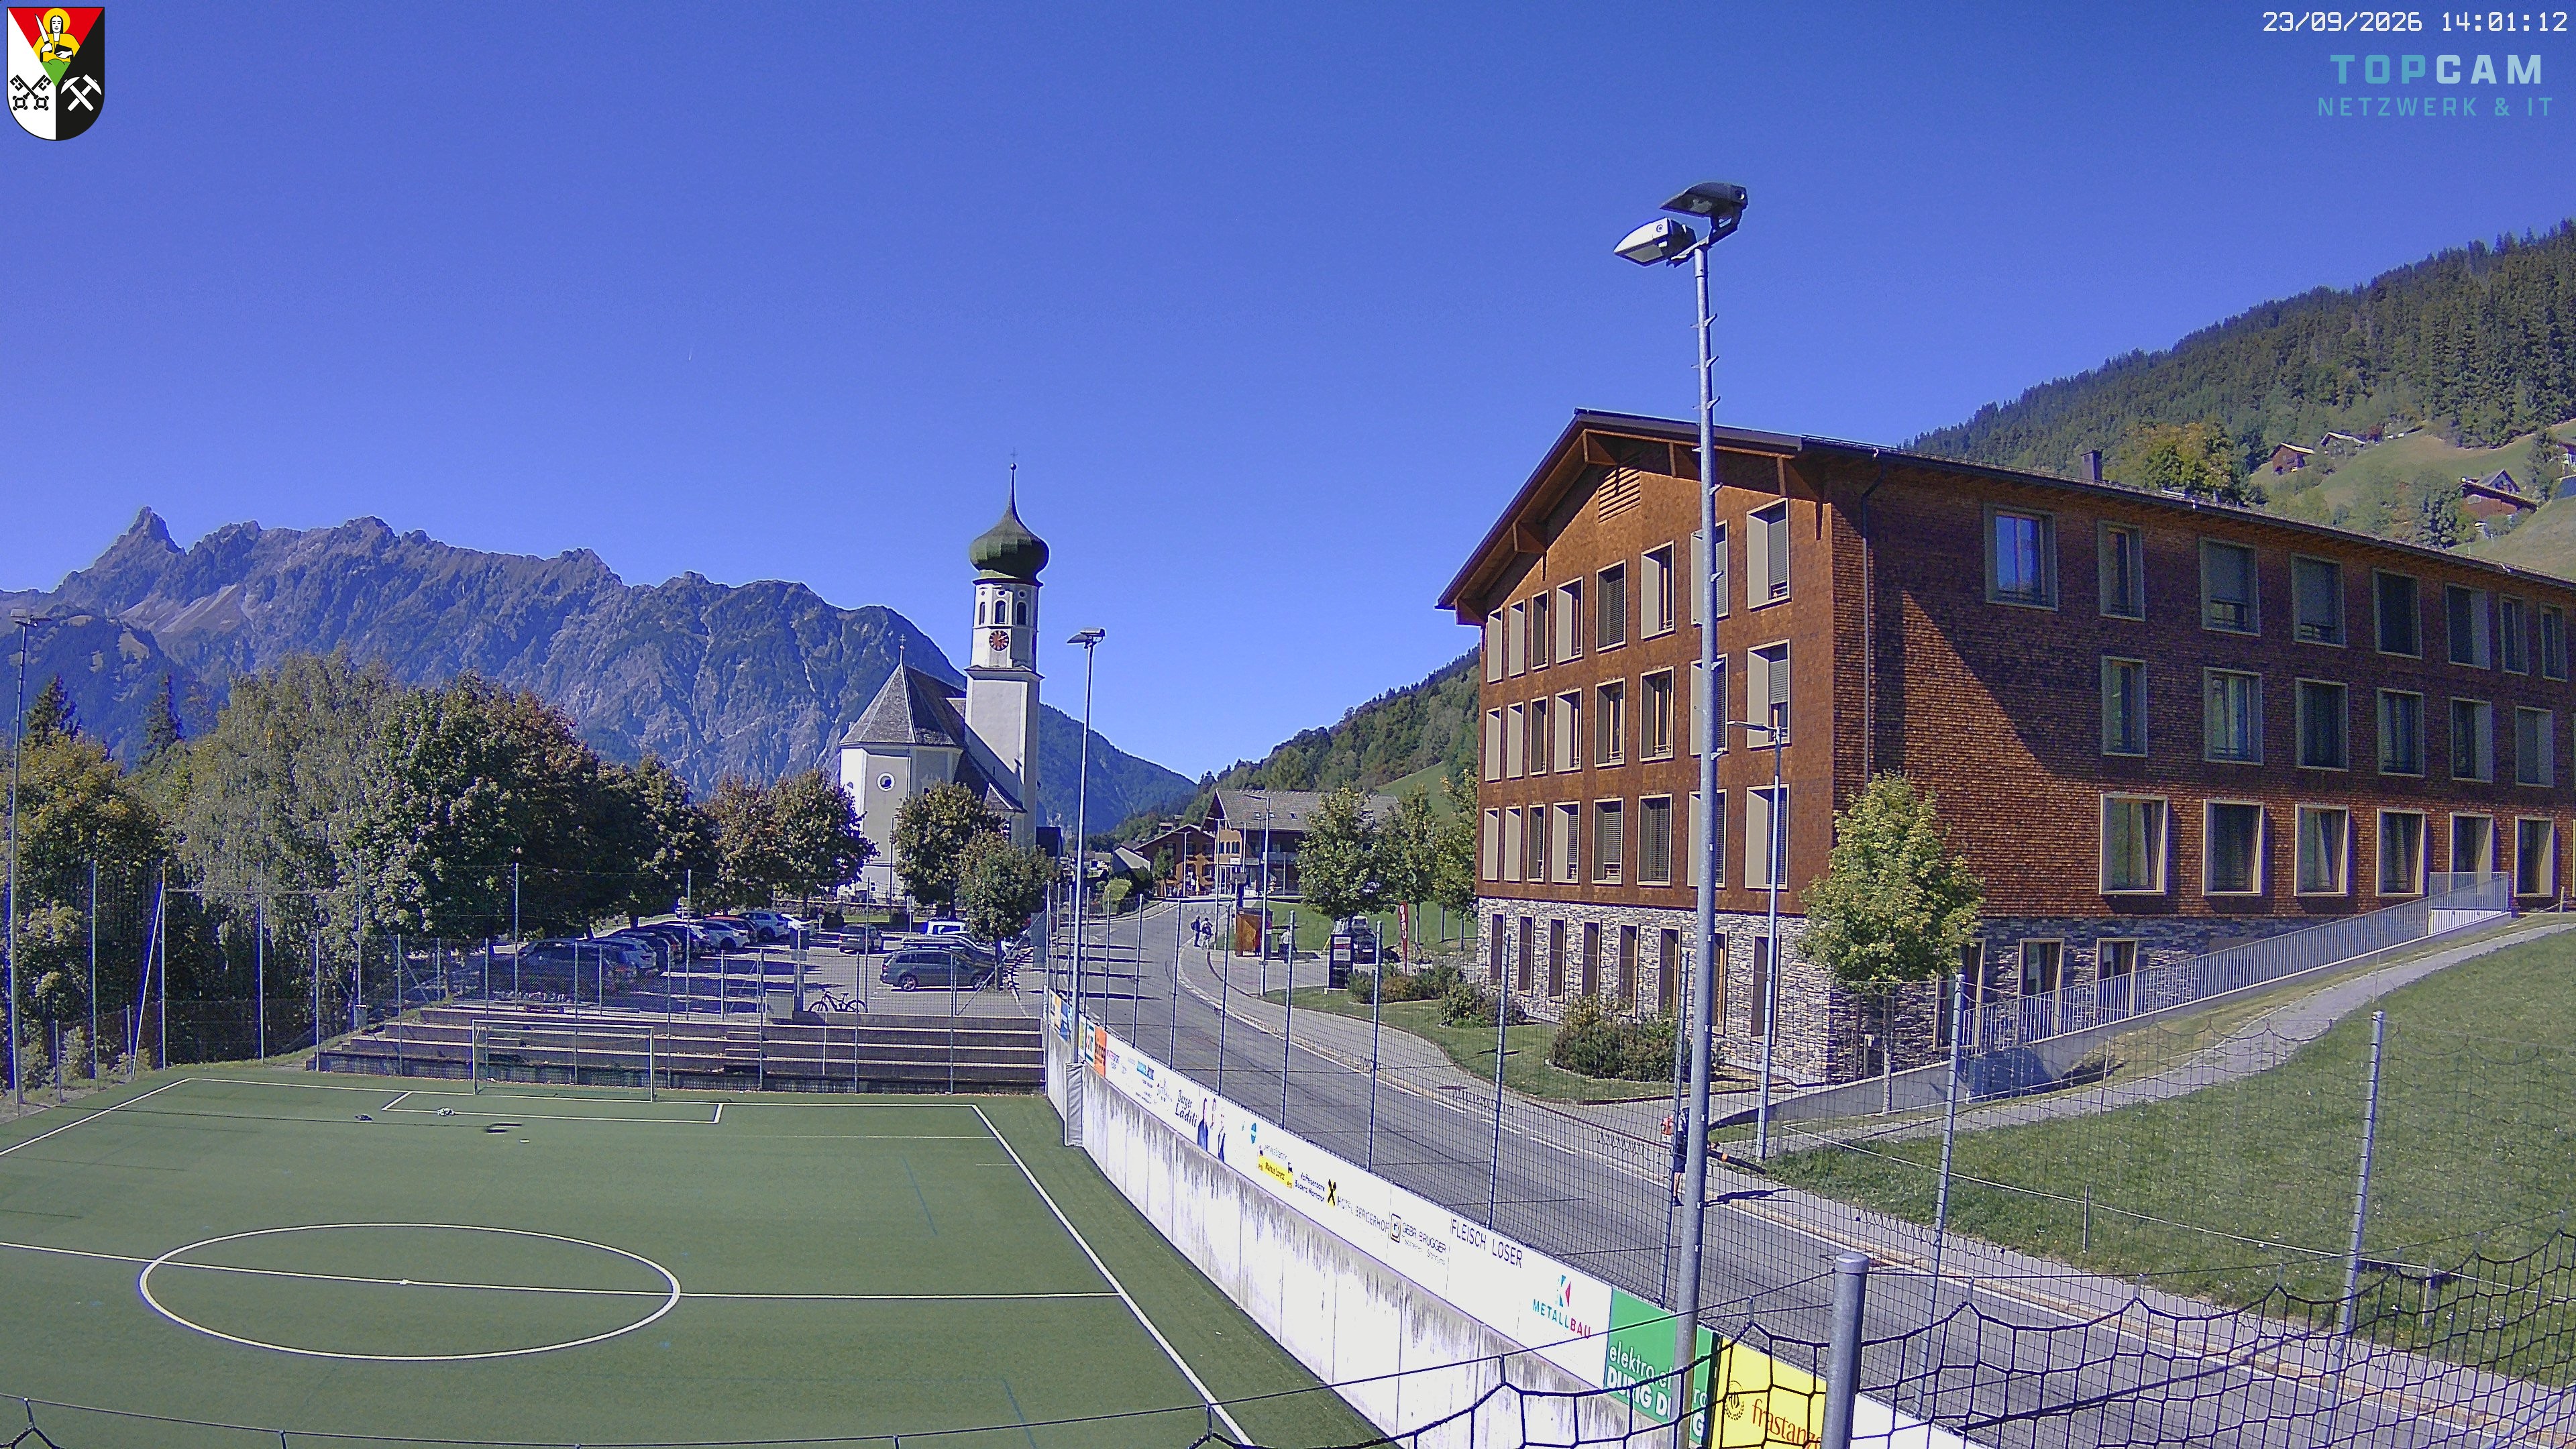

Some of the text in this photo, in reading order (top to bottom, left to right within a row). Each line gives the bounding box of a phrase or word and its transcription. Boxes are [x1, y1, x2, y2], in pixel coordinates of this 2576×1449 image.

[1452, 1218, 1487, 1251] FLEISCH
[1492, 1238, 1523, 1269] LOSER
[1532, 1299, 1591, 1339] METALLBAU
[1609, 1341, 1656, 1382] elektro
